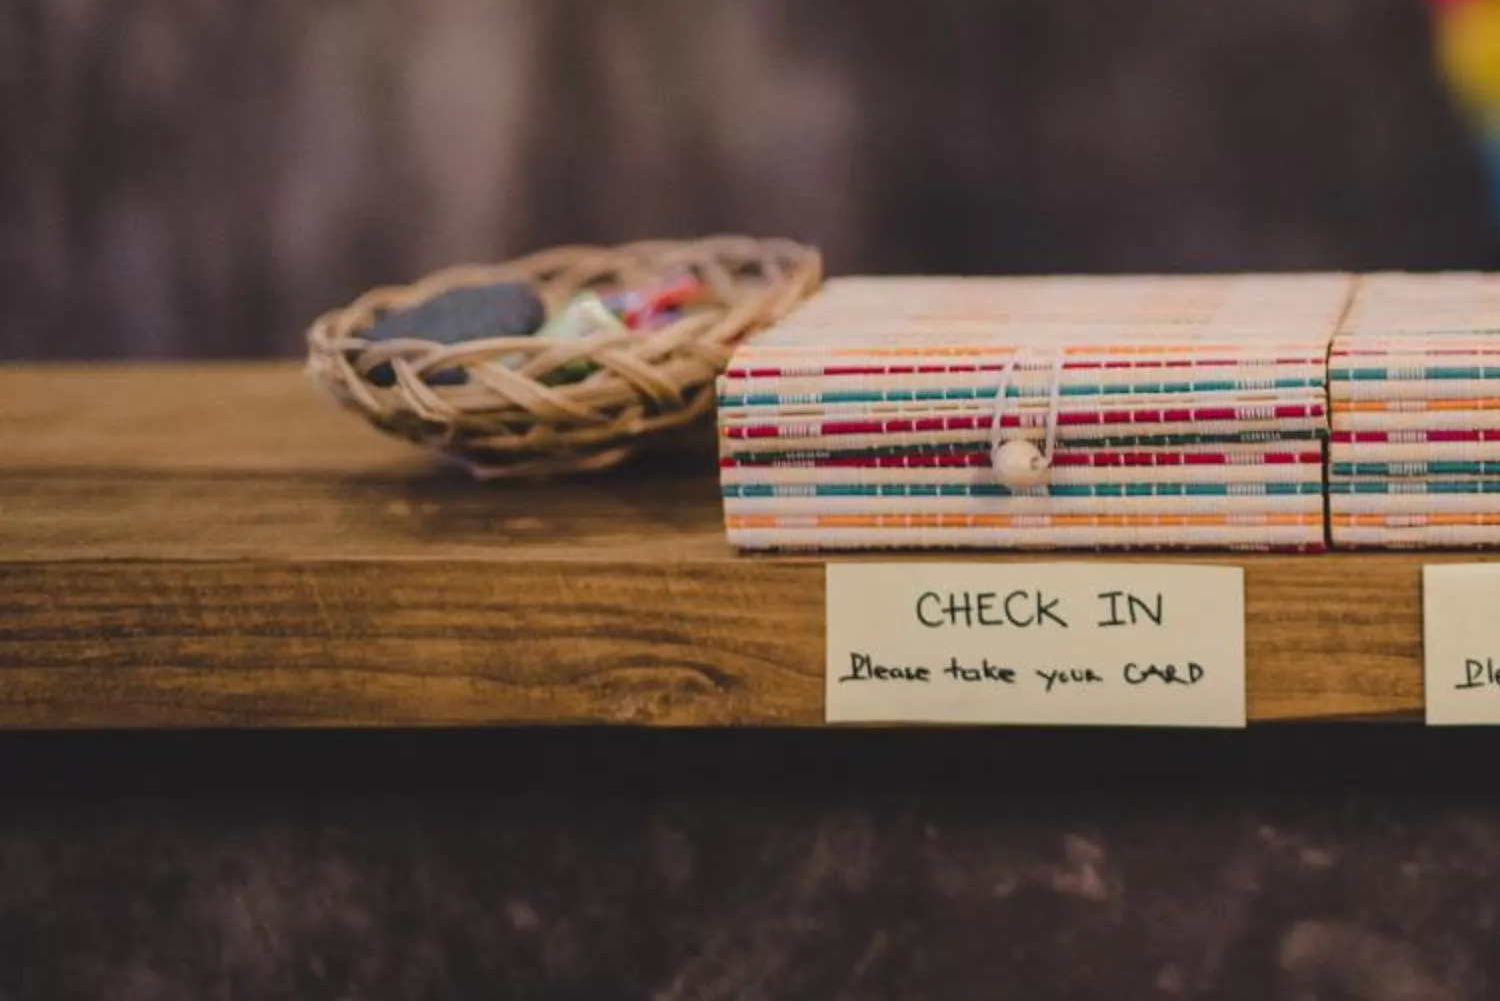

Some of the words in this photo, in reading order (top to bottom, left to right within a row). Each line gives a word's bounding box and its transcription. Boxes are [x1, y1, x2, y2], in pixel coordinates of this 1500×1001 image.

[916, 590, 1068, 628] CHECK
[1097, 590, 1163, 627] IN
[839, 652, 931, 683] Please
[944, 657, 1016, 685] take
[1123, 661, 1204, 686] CARD
